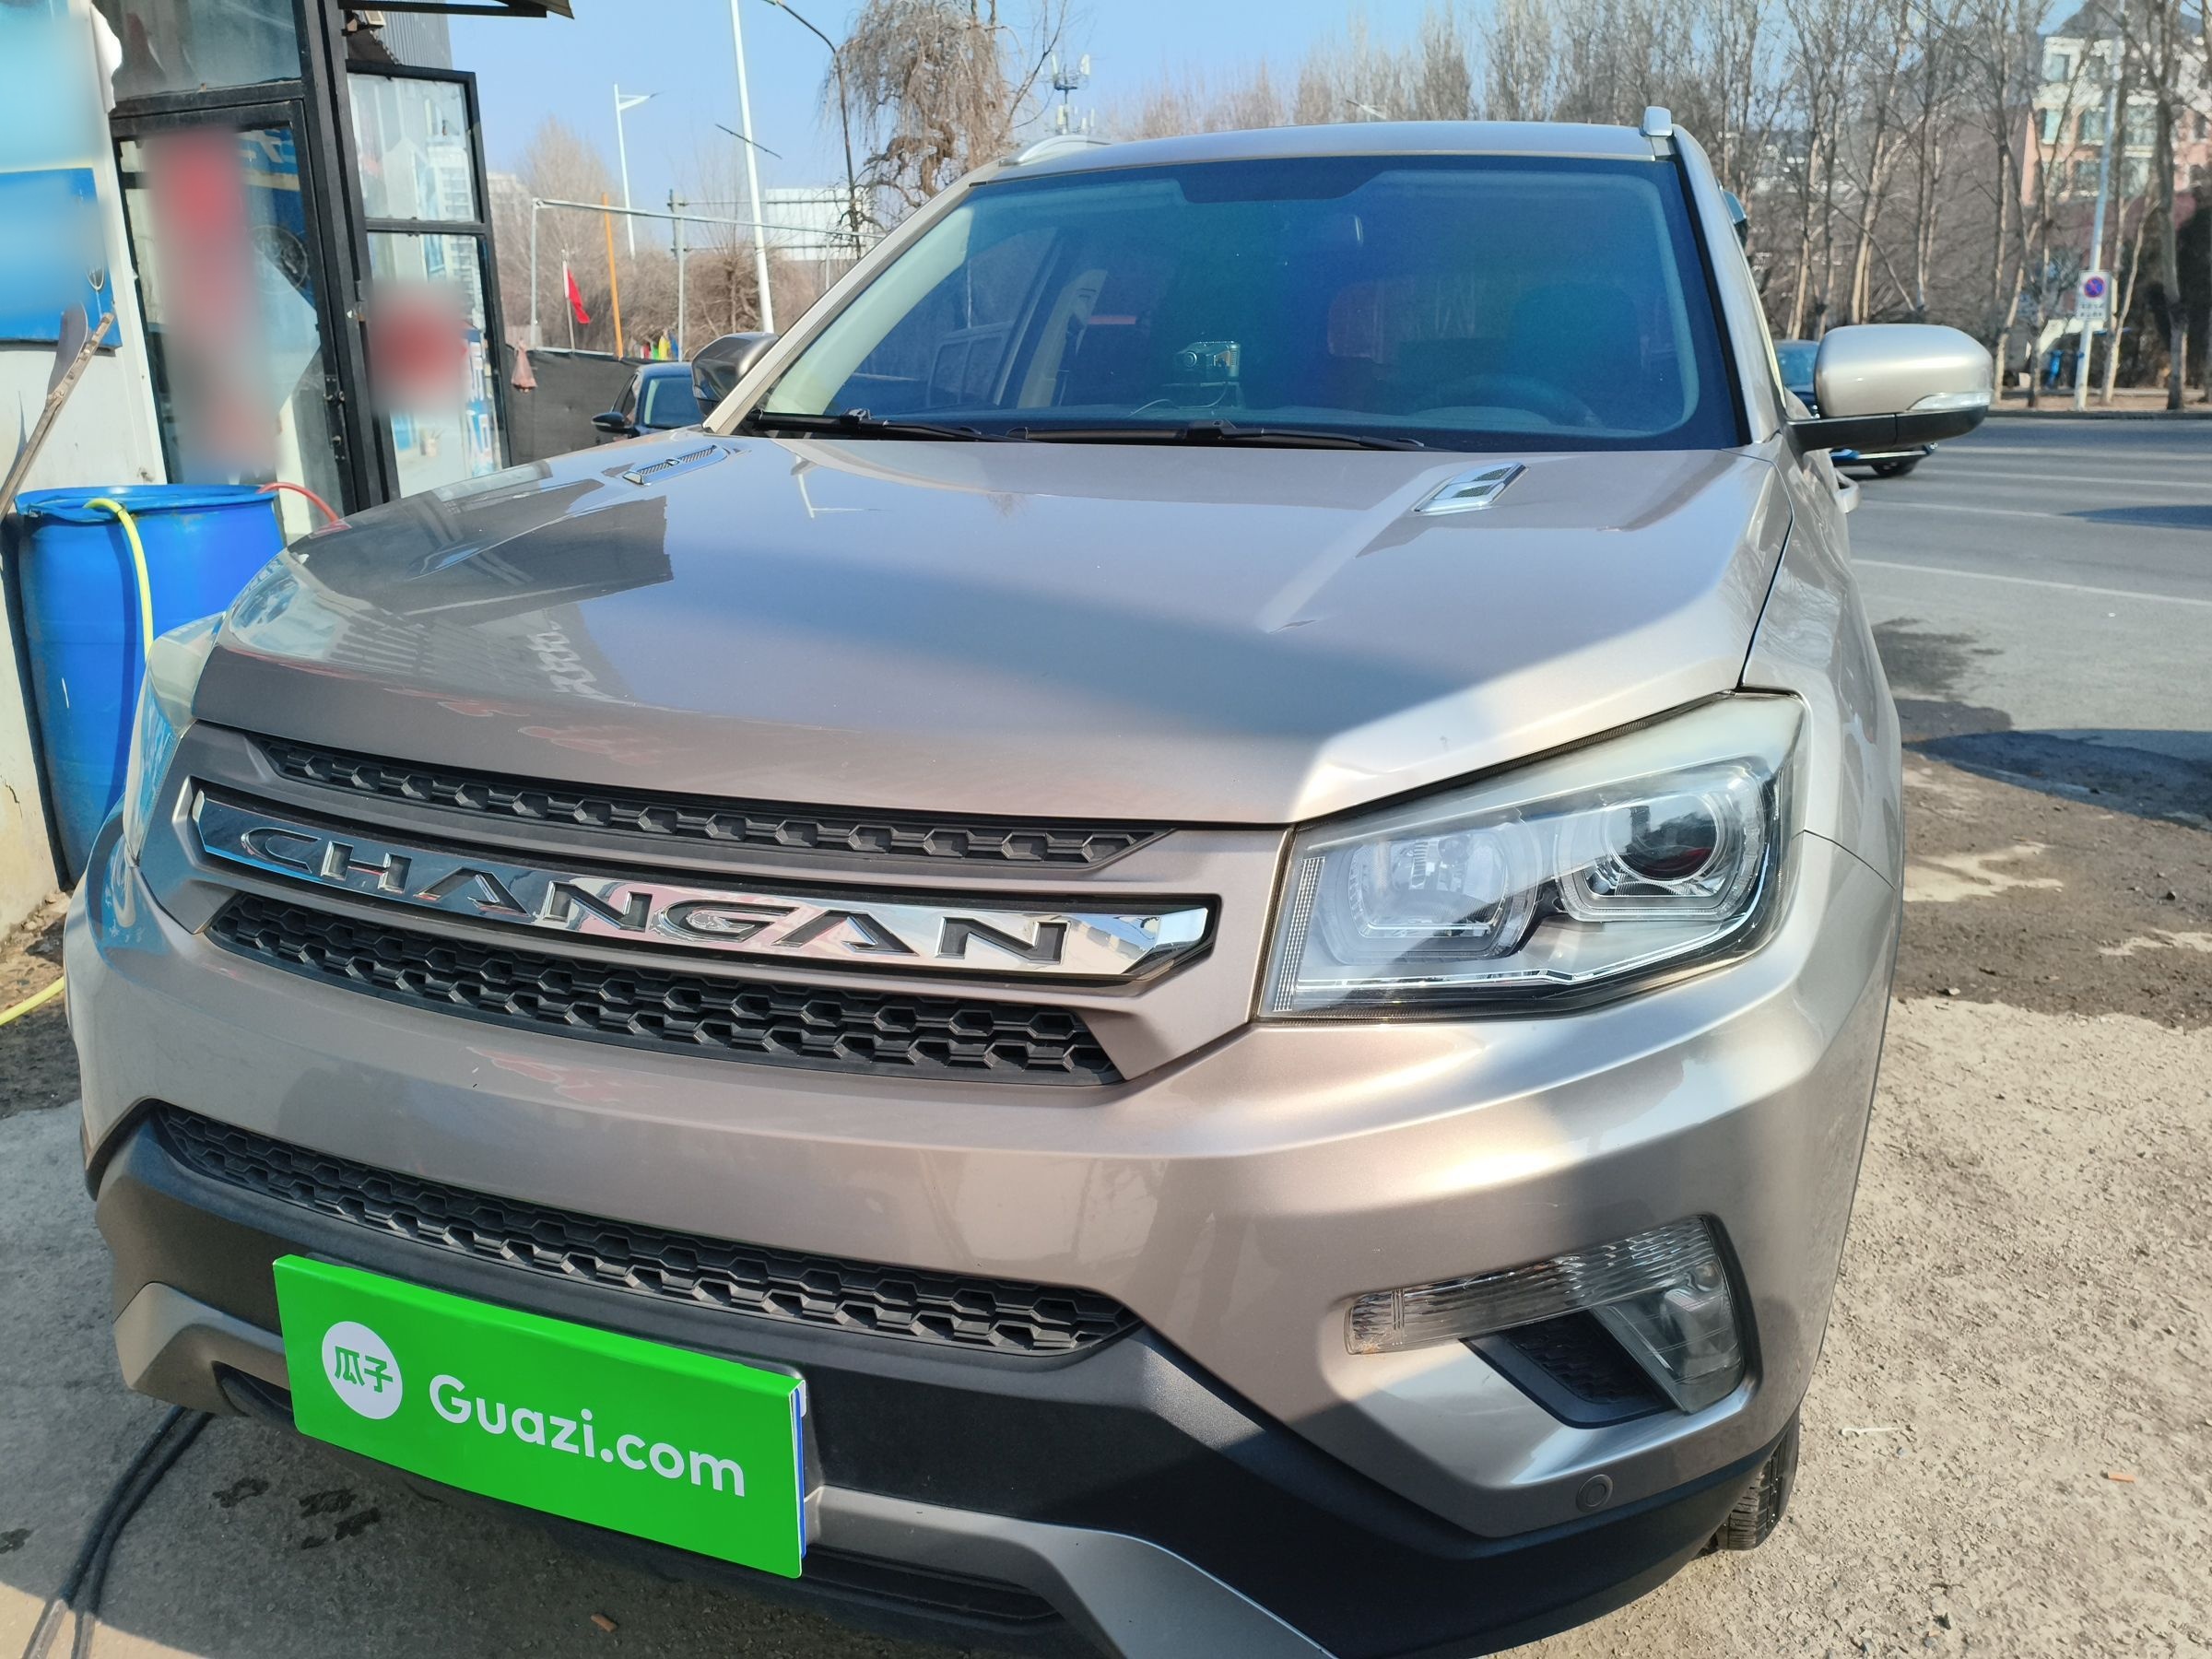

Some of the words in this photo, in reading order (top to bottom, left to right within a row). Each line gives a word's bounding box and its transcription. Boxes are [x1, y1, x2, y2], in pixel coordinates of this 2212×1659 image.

[241, 826, 1071, 964] CHANGAN
[335, 1346, 394, 1393] 瓜子
[429, 1373, 746, 1498] Guazi.com
